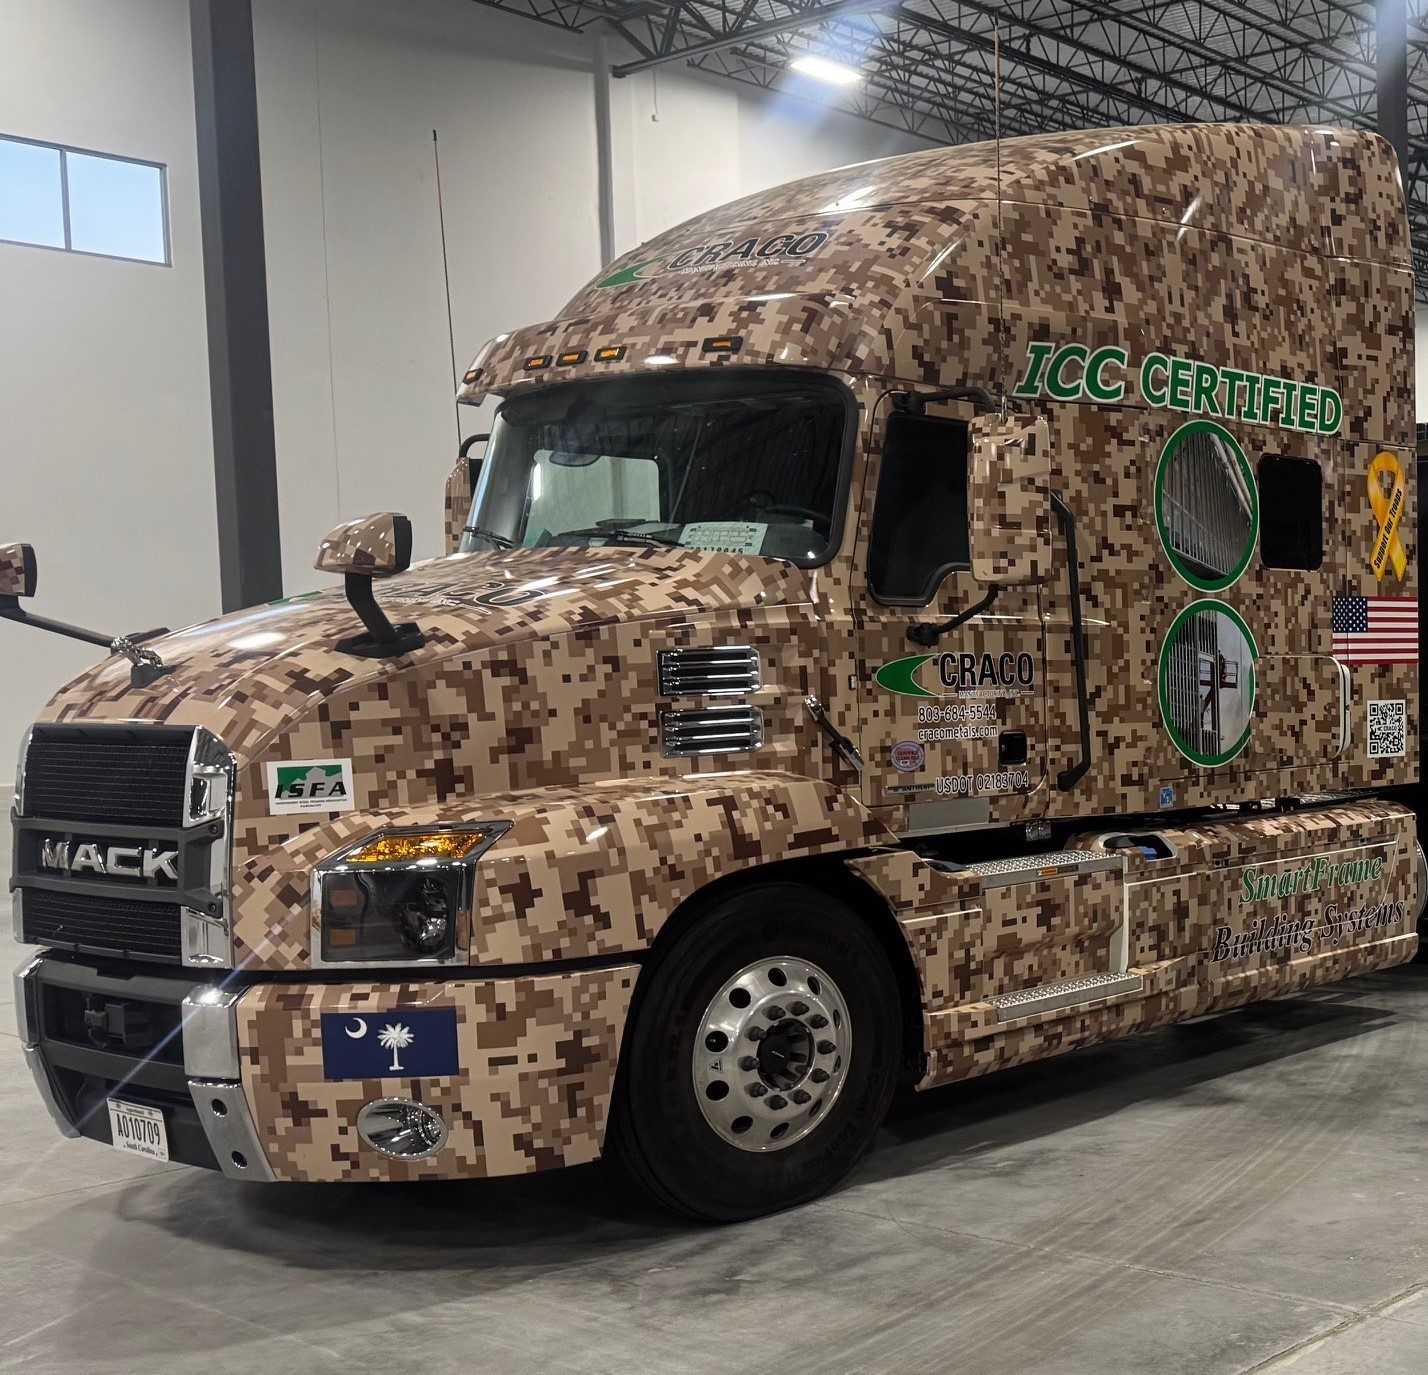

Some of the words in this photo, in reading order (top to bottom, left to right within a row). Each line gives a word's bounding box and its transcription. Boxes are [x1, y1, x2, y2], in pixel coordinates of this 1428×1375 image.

[667, 232, 829, 270] CRACO
[1012, 341, 1127, 403] ICC
[1140, 352, 1343, 435] CERTIFIED
[1373, 533, 1389, 569] Support
[1384, 519, 1393, 533] Our
[1389, 488, 1403, 518] Troops
[939, 651, 1034, 687] CRACO
[918, 704, 997, 722] 803-684-5544
[918, 724, 998, 741] cracometals.com
[275, 781, 347, 798] ISFA
[935, 775, 973, 796] USDOT
[977, 771, 1029, 791] 02183704
[42, 838, 178, 879] MACK
[1239, 855, 1383, 905] SmartFrame
[1210, 913, 1315, 963] Building
[1320, 900, 1405, 945] Systems
[116, 1113, 161, 1146] A010709
